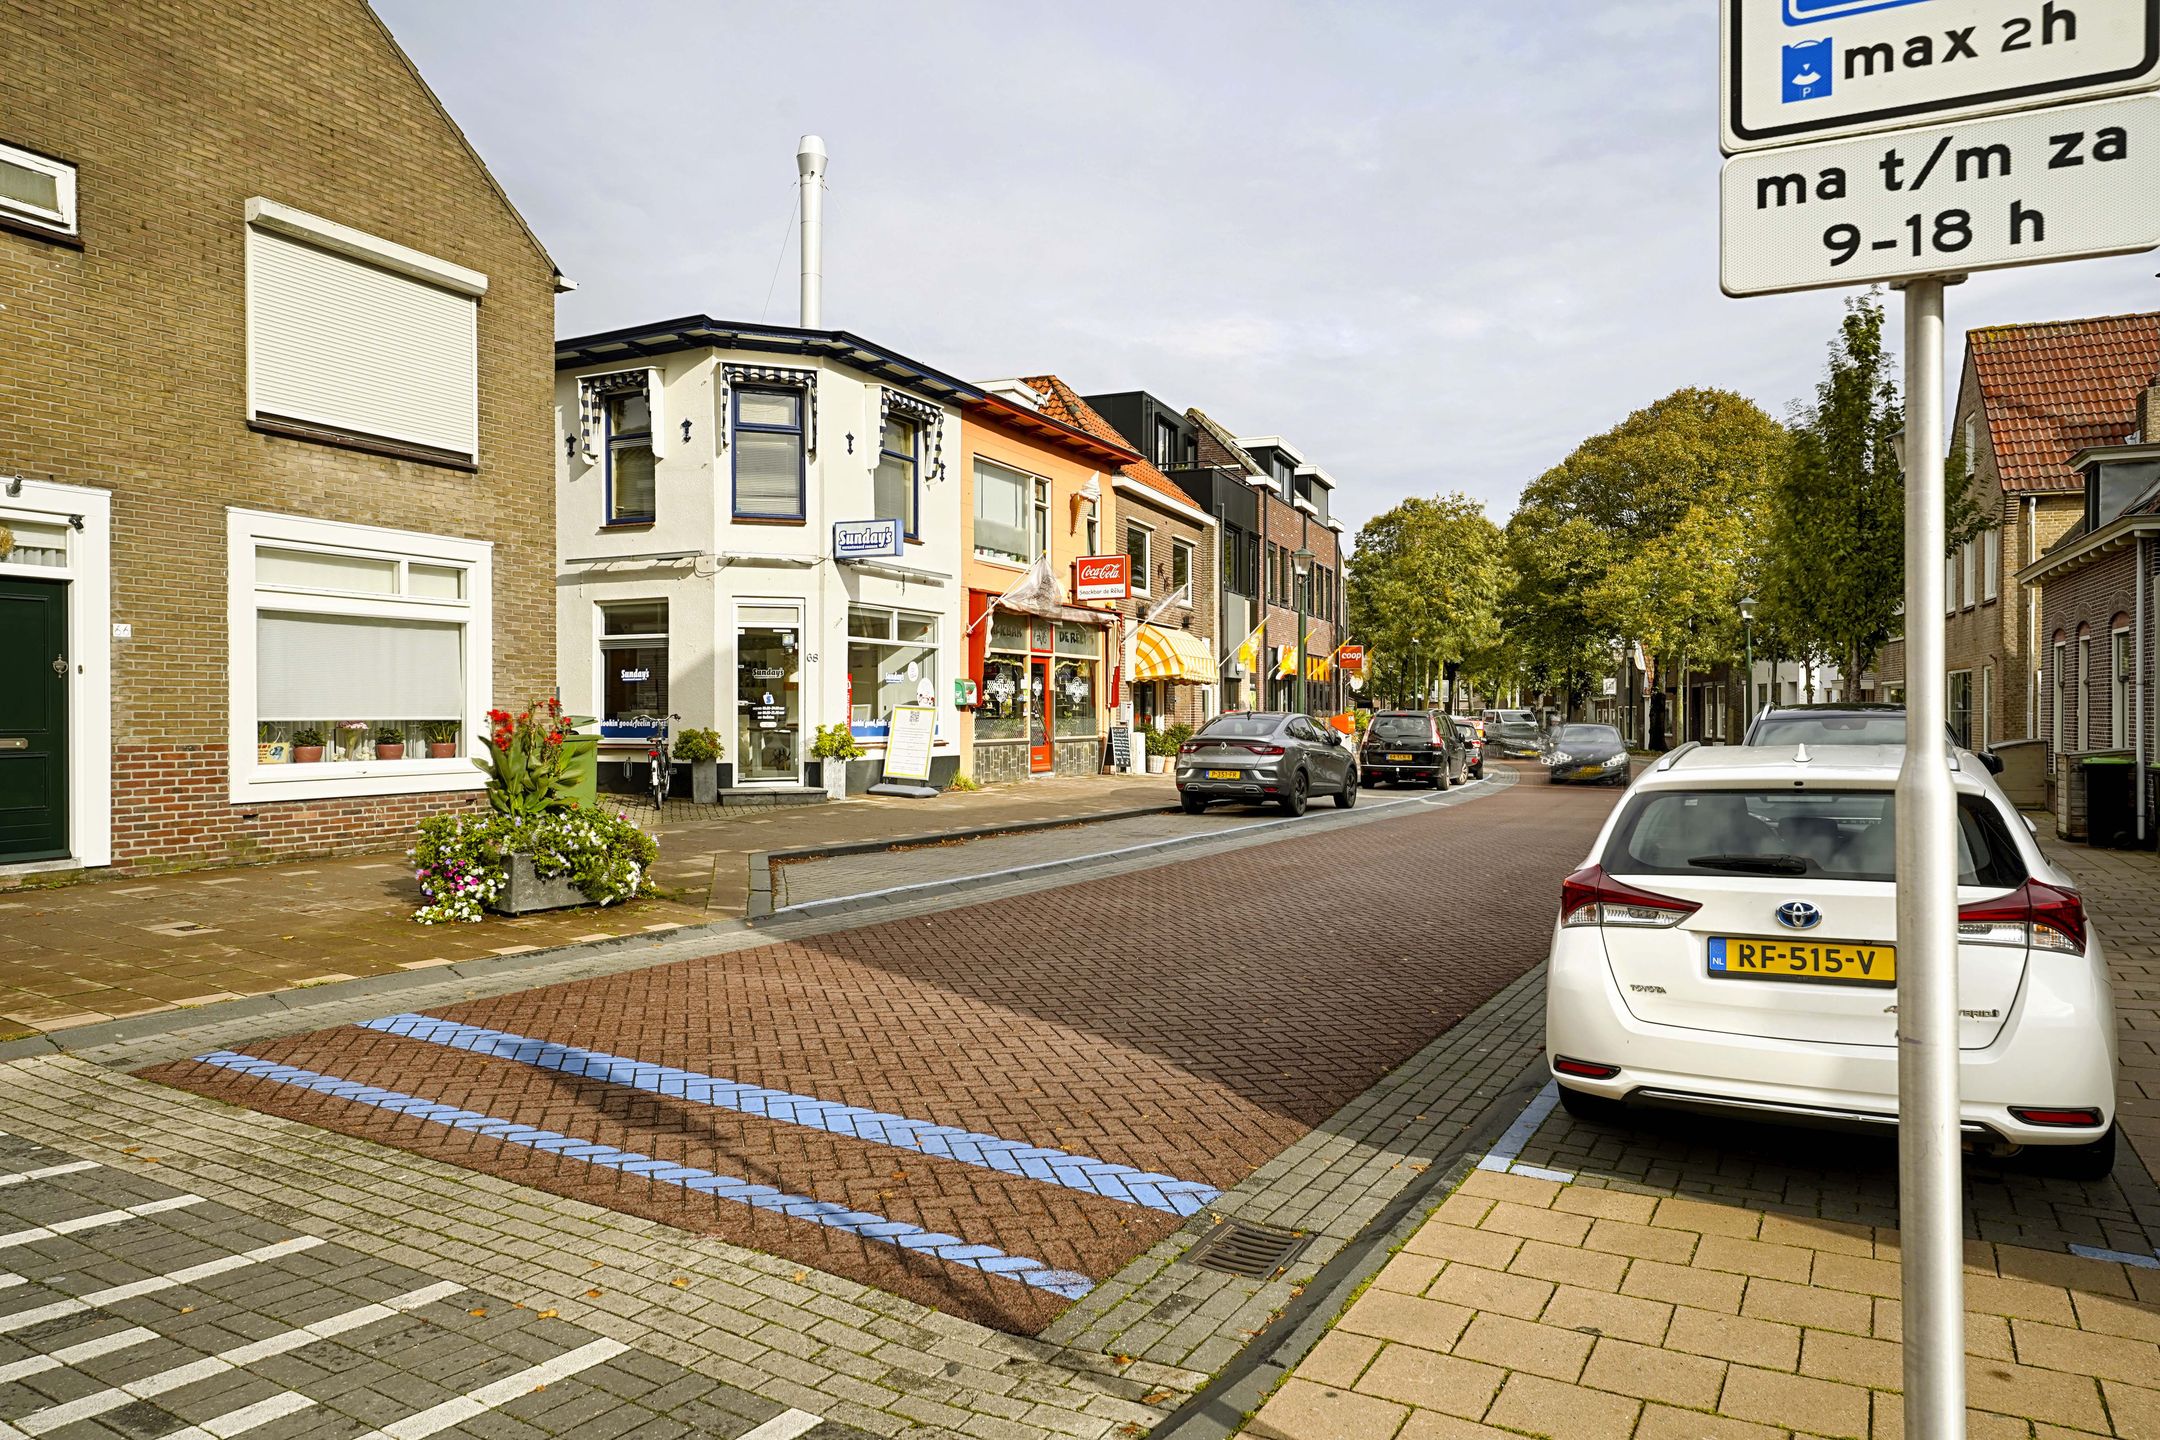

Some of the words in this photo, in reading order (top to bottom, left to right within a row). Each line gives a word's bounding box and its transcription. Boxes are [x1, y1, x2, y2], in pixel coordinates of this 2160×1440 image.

[1844, 26, 1979, 80] max
[1757, 166, 1846, 209] ma
[1879, 135, 2012, 191] t/m
[2048, 126, 2127, 169] za
[1823, 208, 1973, 266] 9-18
[2010, 199, 2044, 245] h
[838, 526, 893, 548] Sunday's
[806, 653, 819, 663] 68
[1341, 652, 1362, 661] coop
[621, 668, 650, 680] Sunday's
[752, 667, 784, 678] Sunday's
[1712, 957, 1725, 967] NL
[1738, 944, 1876, 975] RF-515-V
[1630, 984, 1667, 994] TOYOTA
